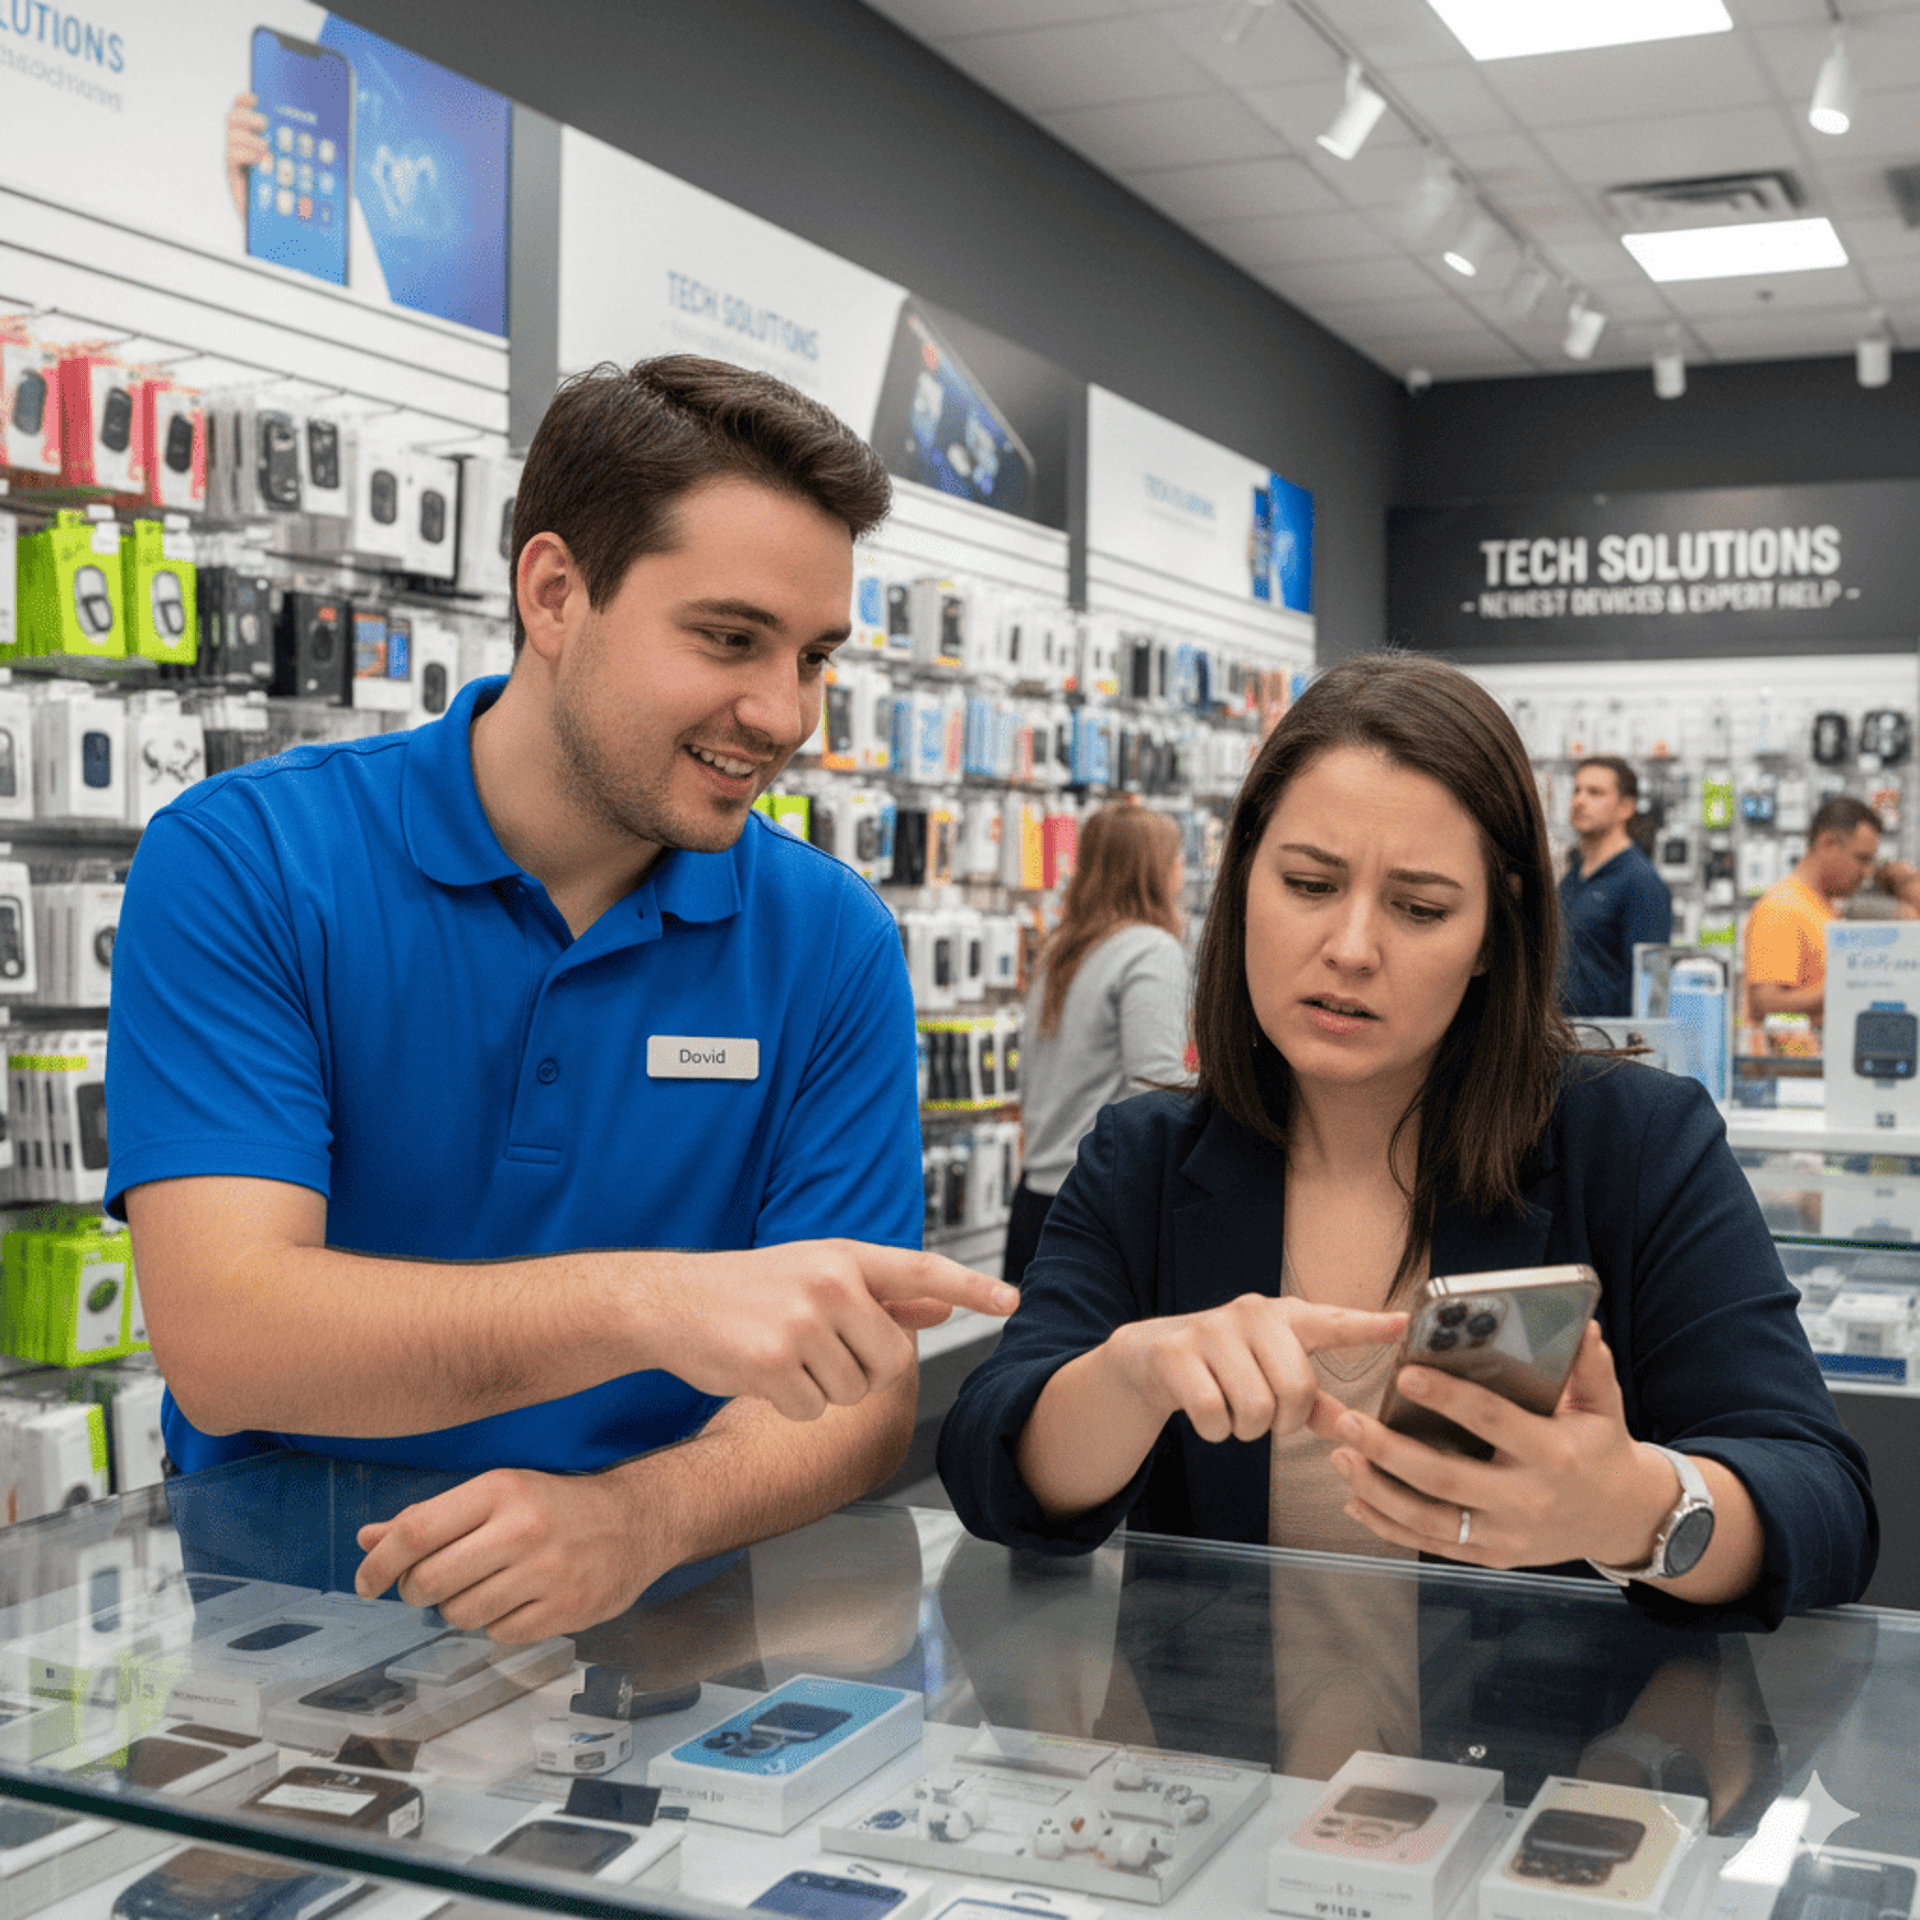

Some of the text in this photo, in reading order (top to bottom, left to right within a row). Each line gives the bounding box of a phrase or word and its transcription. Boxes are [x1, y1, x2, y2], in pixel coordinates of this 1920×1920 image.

[668, 270, 718, 321] TECH
[723, 293, 819, 361] SOLUTIONS
[1479, 524, 1841, 586] TECH SOLUTIONS
[1479, 588, 1567, 619] NEWEST
[1571, 584, 1665, 616] DEVICES
[1688, 580, 1775, 613] EXPERT
[1777, 578, 1842, 609] HELP
[680, 1048, 726, 1064] Dovid
